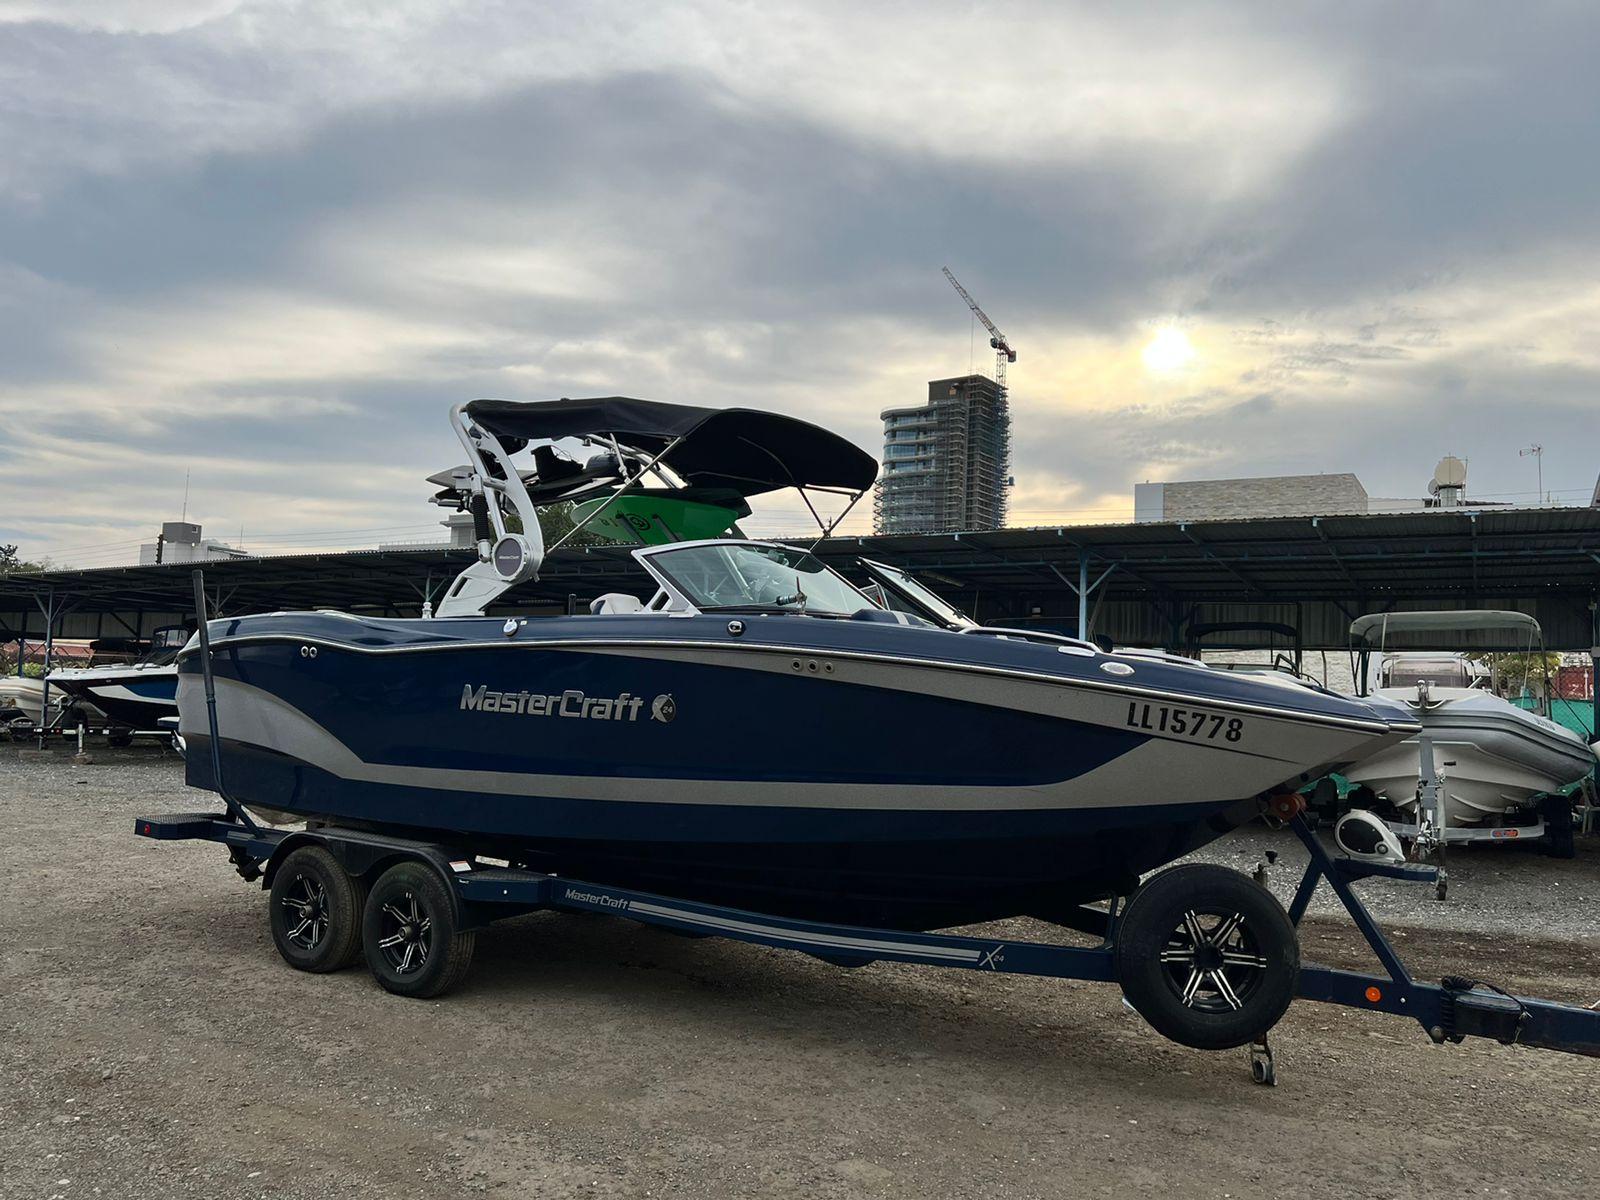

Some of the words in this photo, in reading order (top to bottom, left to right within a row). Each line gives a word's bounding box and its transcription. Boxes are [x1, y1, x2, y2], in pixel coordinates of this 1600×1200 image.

[460, 683, 644, 722] MasterCraft
[1127, 702, 1244, 742] LL15778
[565, 888, 629, 909] MasterCraft
